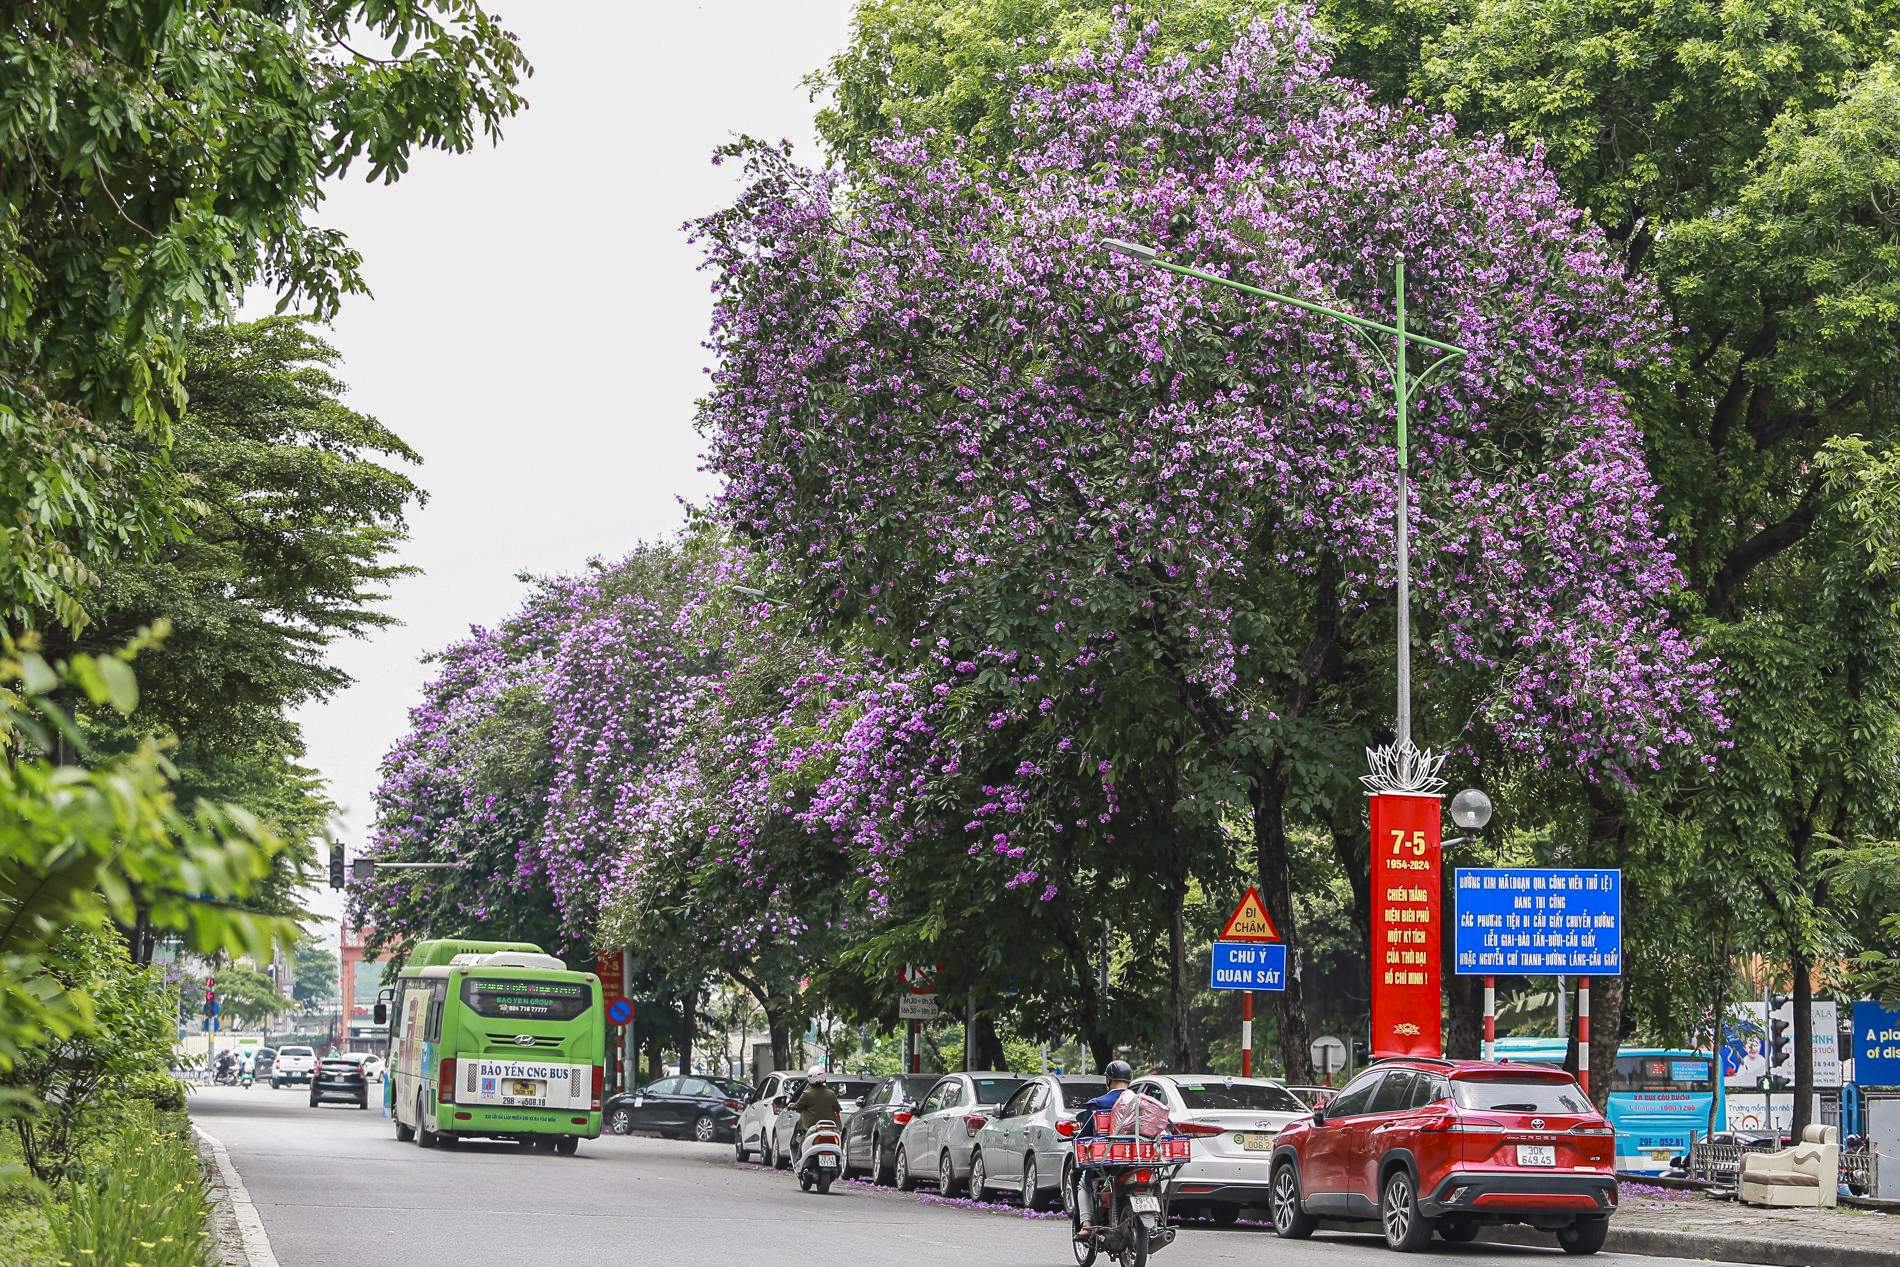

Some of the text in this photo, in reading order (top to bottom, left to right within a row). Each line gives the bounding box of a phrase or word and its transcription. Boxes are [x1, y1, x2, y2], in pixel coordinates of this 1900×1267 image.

[1391, 829, 1426, 856] 7-5
[1386, 859, 1430, 870] 1954-2024
[1460, 872, 1480, 889] ĐƯỜNG
[1484, 877, 1496, 889] KIM
[1533, 877, 1546, 891] QUA
[1549, 874, 1566, 890] CÔNG
[1568, 874, 1583, 890] VIÊN
[1586, 874, 1598, 890] THỦ
[1387, 884, 1428, 902] CHIẾN THẮNG
[1514, 894, 1566, 909] ĐANG THI CÔNG
[1246, 908, 1256, 918] ĐI
[1384, 906, 1430, 925] ĐIỆN BIÊN PHỦ
[1461, 908, 1615, 930] CÁC PHƯƠNG TIỆN ĐI CẦU GIẤY CHUYỂN HƯỚNG
[1235, 921, 1266, 935] CHẬM
[1387, 928, 1402, 945] MỘT
[1412, 928, 1426, 943] TÍCH
[1484, 929, 1498, 946] LIỄU
[1581, 929, 1596, 947] GIẤY
[1229, 947, 1267, 964] CHÚ Ý
[1386, 947, 1427, 967] CỦA THỜI ĐẠI
[1460, 950, 1476, 968] HOẶC
[1479, 947, 1504, 966] NGUYỄN
[1507, 949, 1518, 966] CHÍ
[1604, 947, 1618, 966] GIẤY
[1216, 968, 1280, 984] QUAN SÁT
[1384, 967, 1394, 984] HỒ
[1394, 969, 1407, 984] CHÍ
[1408, 972, 1424, 985] MINH
[1811, 1009, 1833, 1018] ALA
[1866, 1028, 1877, 1041] A
[1866, 1046, 1880, 1059] of
[481, 1060, 569, 1079] BẢO YẾN CNG BUS
[502, 1096, 515, 1105] 29B
[524, 1098, 546, 1107] 508.18
[1528, 1146, 1544, 1155] 30K
[1639, 1138, 1653, 1146] 29F
[1659, 1138, 1684, 1147] 052.81
[1522, 1155, 1552, 1165] 649.45
